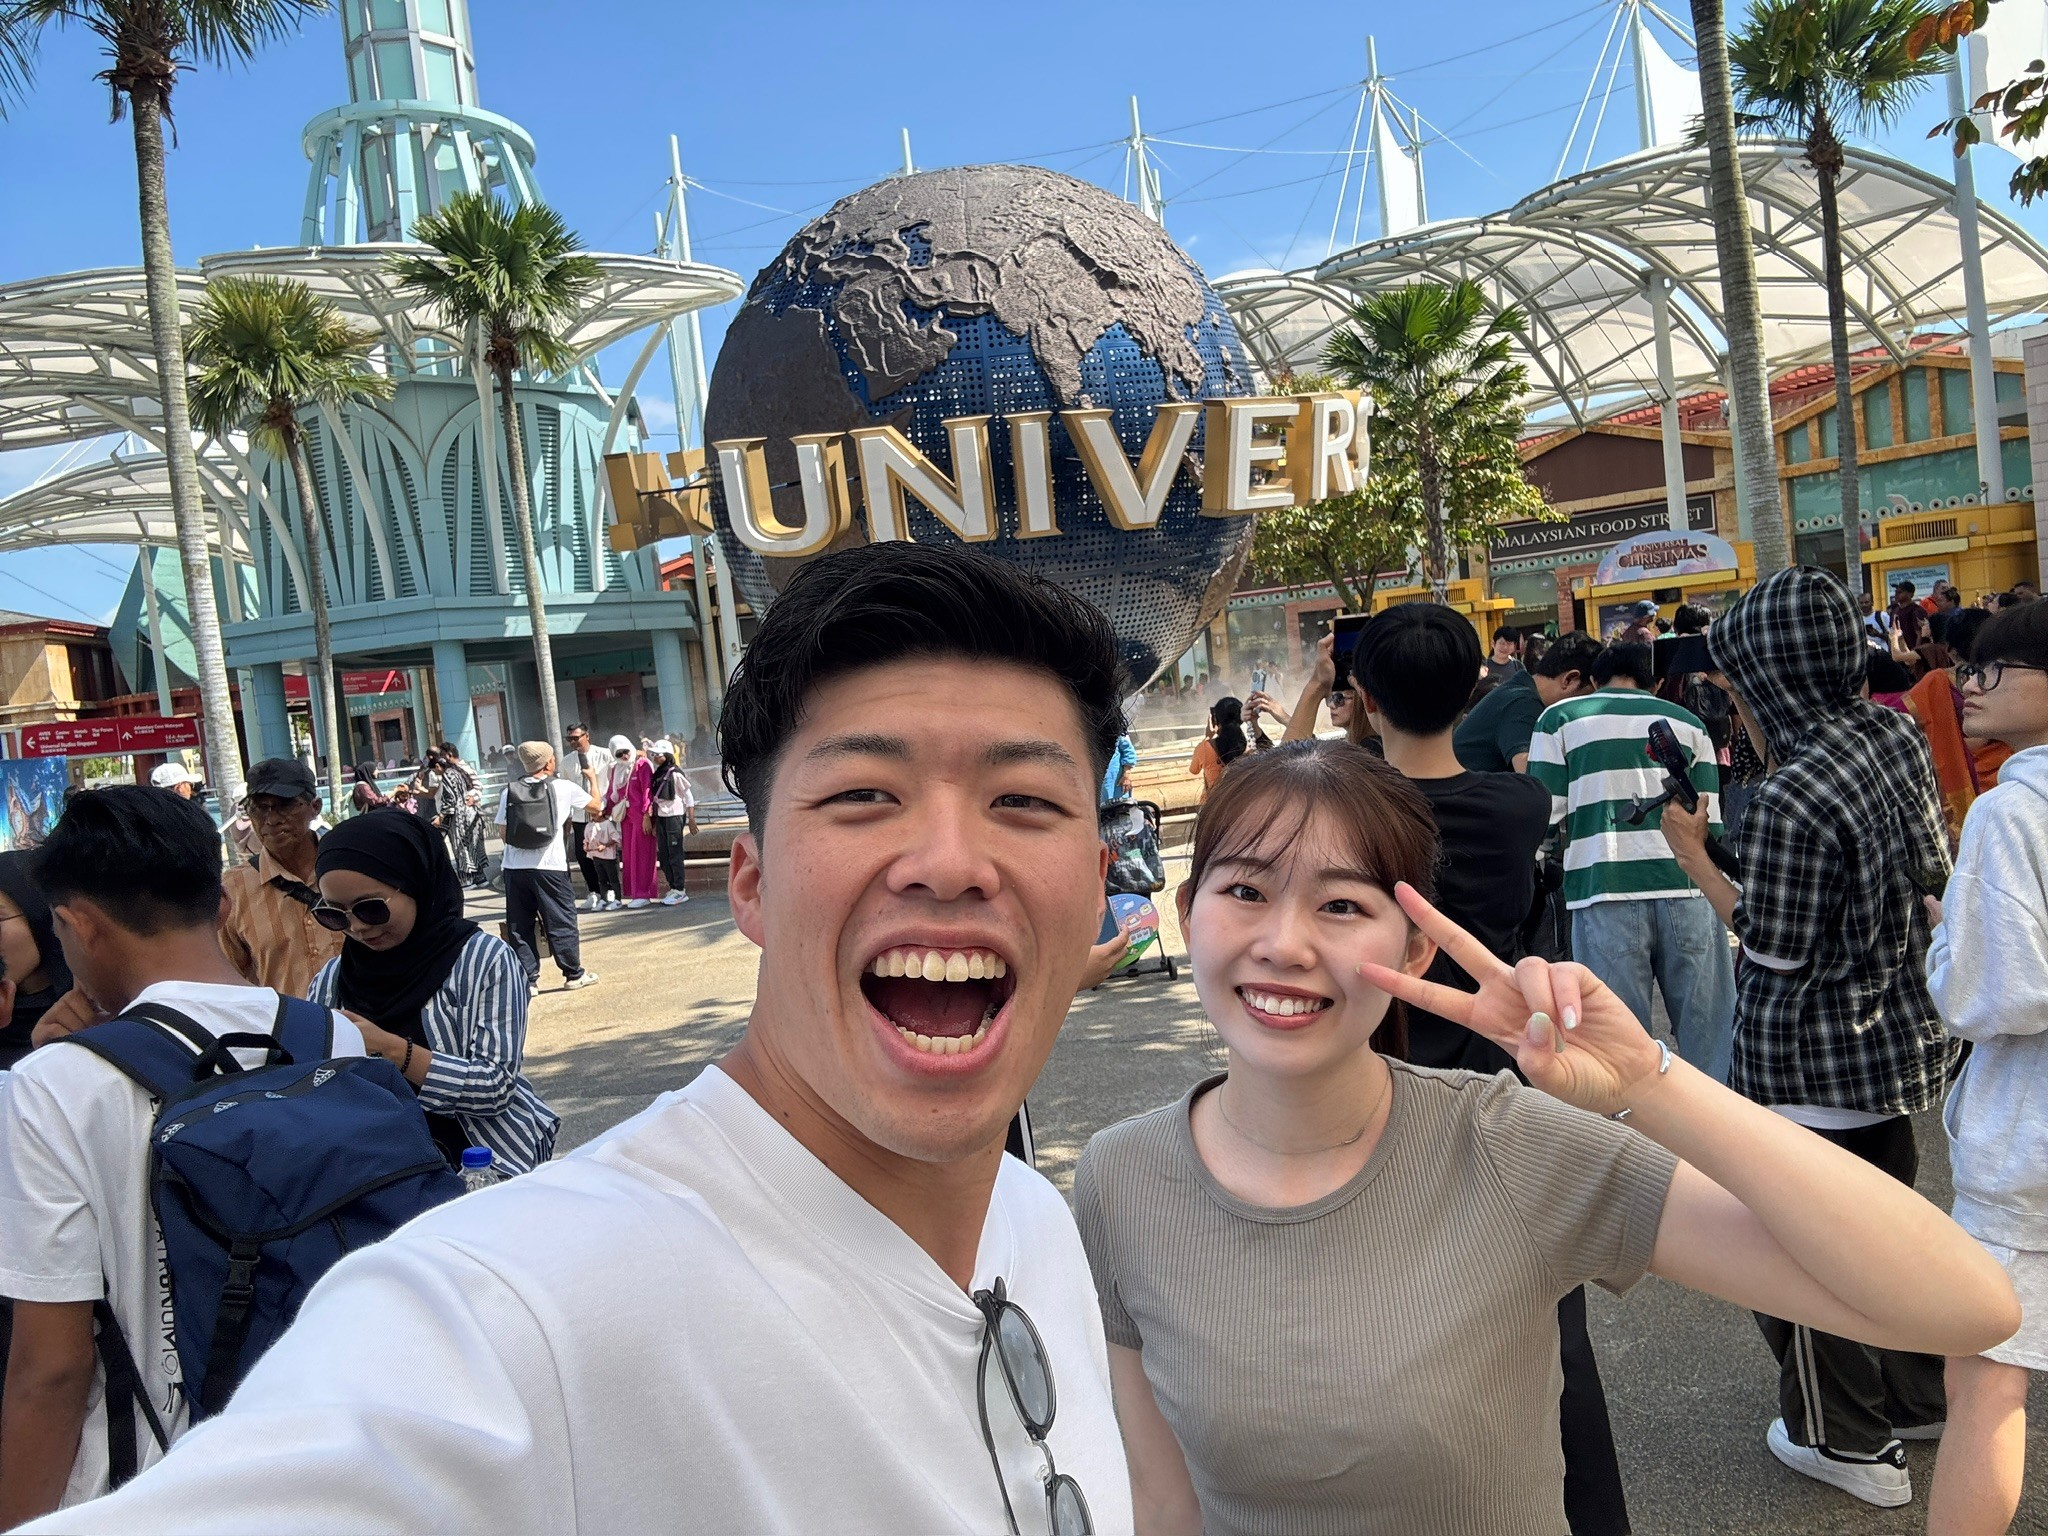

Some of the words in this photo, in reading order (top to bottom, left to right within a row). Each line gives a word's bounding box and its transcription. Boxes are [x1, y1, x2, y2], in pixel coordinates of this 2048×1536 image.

[1496, 524, 1587, 550] MALAYSIAN
[1590, 517, 1637, 536] FOOD
[1640, 506, 1705, 528] STRET
[1616, 543, 1710, 569] CHRISTMAS
[1639, 539, 1686, 552] UNIVERSAL
